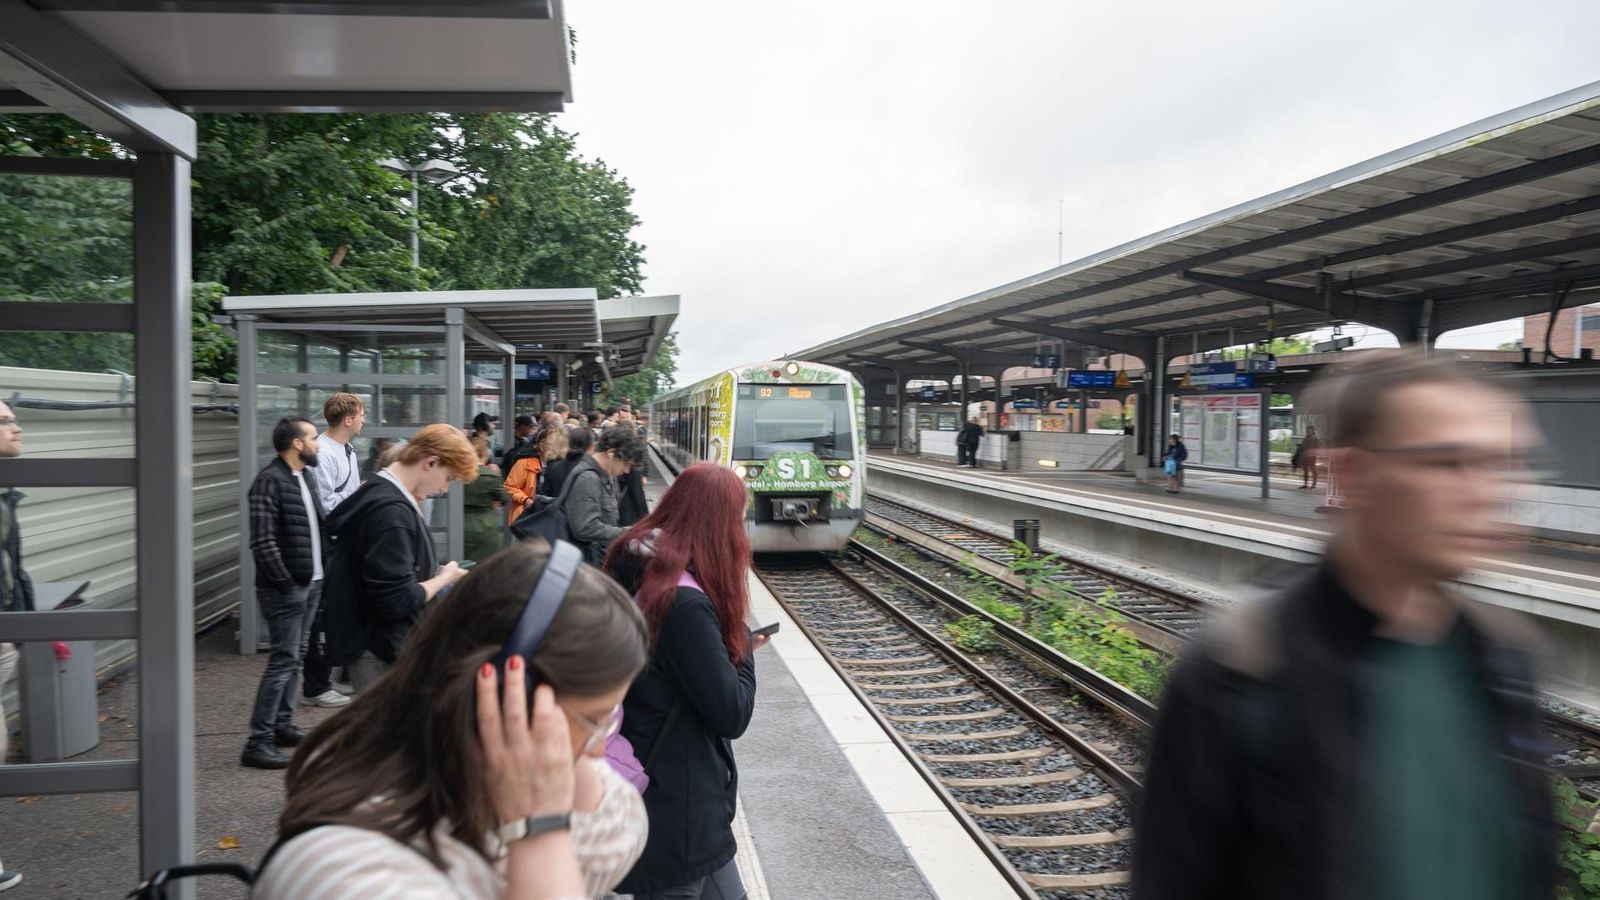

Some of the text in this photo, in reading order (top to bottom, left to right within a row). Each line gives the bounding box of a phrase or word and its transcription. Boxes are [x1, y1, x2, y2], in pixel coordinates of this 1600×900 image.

[760, 388, 772, 398] S2
[745, 480, 765, 489] edel
[774, 480, 817, 490] Hamburg
